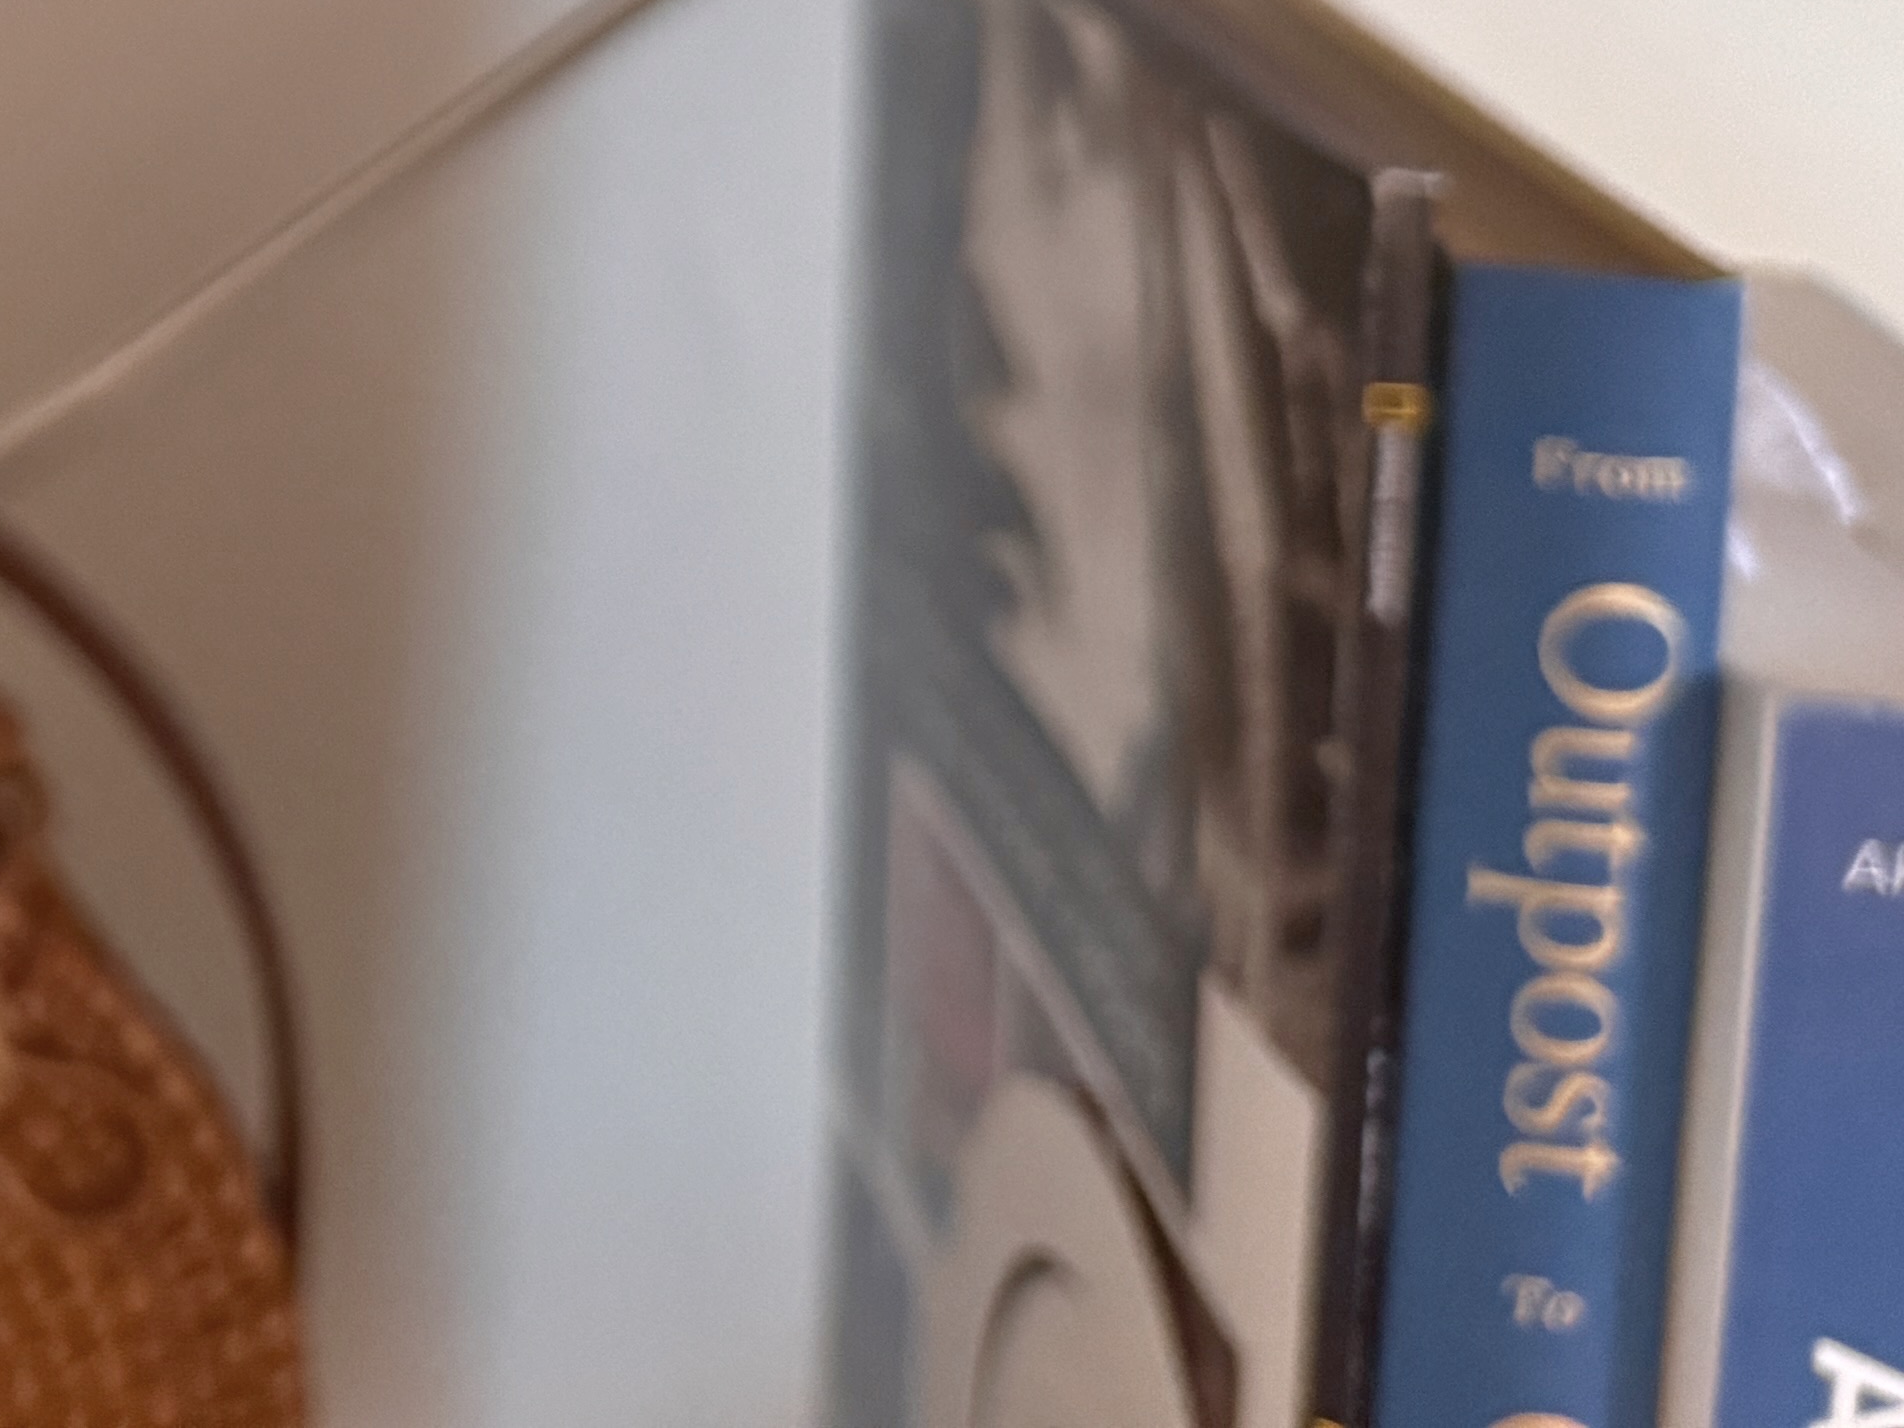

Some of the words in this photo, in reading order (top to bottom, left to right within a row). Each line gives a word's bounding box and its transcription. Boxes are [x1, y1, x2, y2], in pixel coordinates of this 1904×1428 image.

[1534, 435, 1690, 499] From
[1466, 582, 1684, 1200] Outpost
[1501, 1274, 1583, 1332] To
